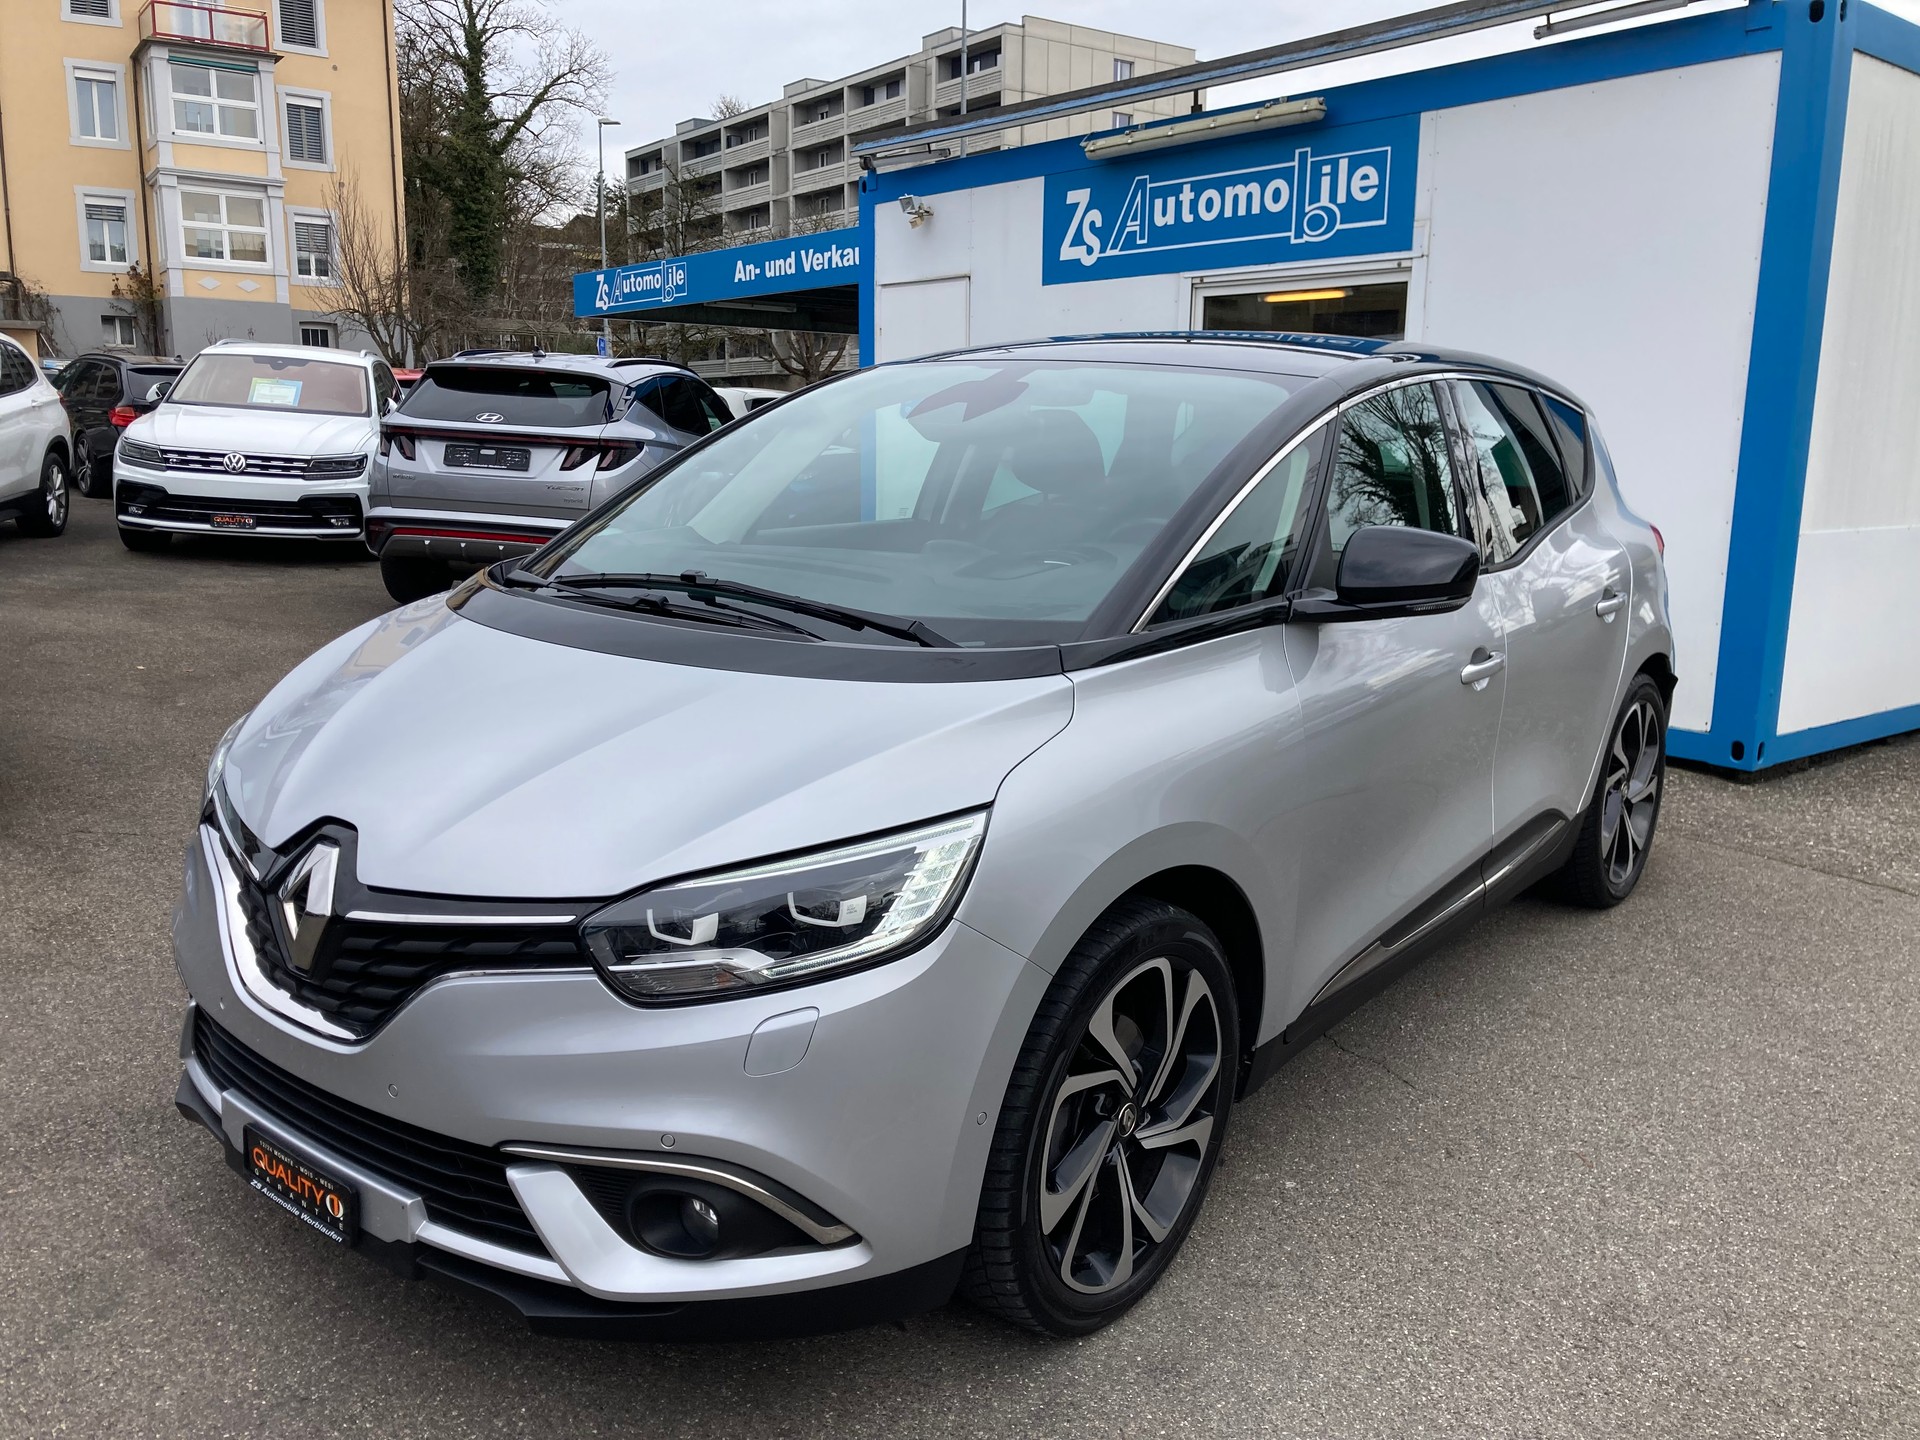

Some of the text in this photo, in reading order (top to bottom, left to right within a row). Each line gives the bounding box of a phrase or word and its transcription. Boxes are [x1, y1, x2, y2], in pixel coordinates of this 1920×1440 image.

[1106, 147, 1380, 254] Automobile
[610, 261, 685, 305] Automobile
[734, 260, 760, 283] An-
[765, 251, 796, 279] und
[253, 1148, 325, 1206] QUALITY
[273, 1150, 293, 1167] MONATE
[299, 1166, 313, 1179] MOIS
[254, 1168, 344, 1231] GARANTIE
[261, 1187, 300, 1216] Automobile
[300, 1212, 343, 1243] Worblaufen
